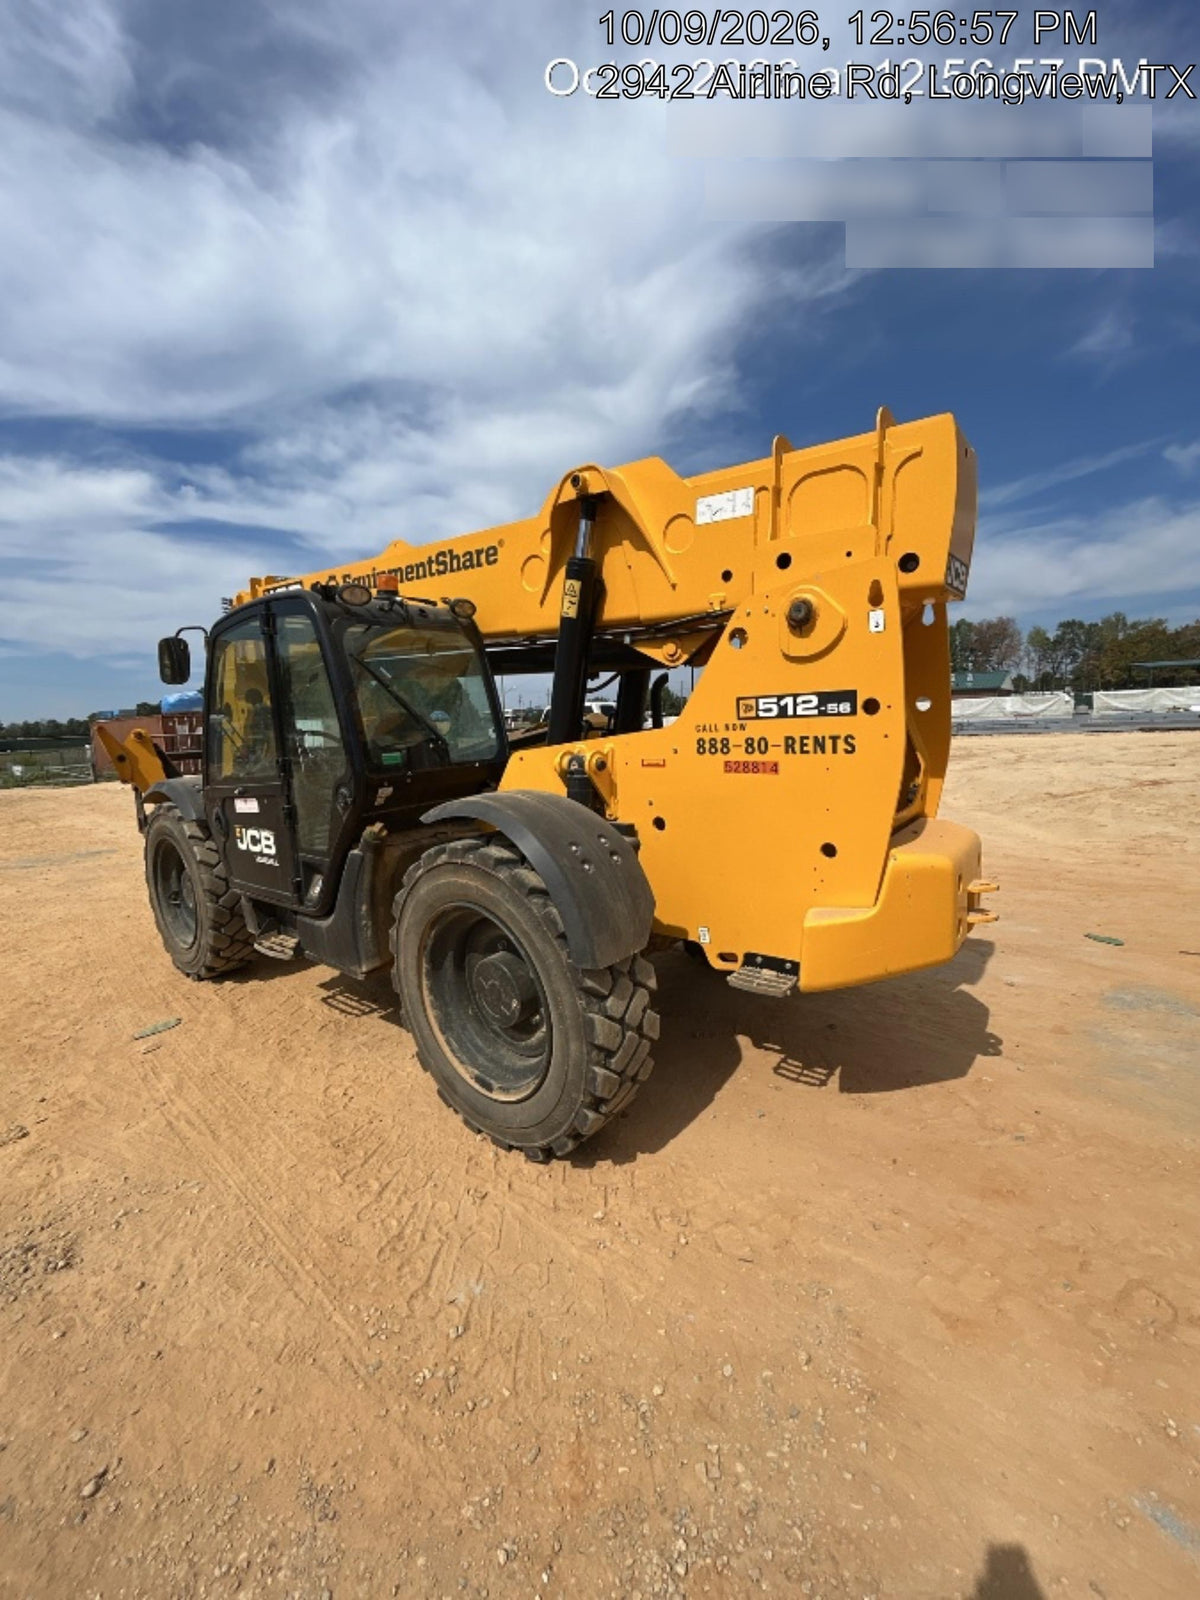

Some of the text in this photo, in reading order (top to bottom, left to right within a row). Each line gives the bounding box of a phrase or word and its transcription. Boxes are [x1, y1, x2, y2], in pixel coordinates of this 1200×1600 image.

[757, 694, 851, 718] 512-56
[695, 722, 747, 733] CALL NOW
[696, 734, 857, 755] 888-80-RENTS
[724, 761, 779, 775] 528814
[235, 827, 276, 855] JCB
